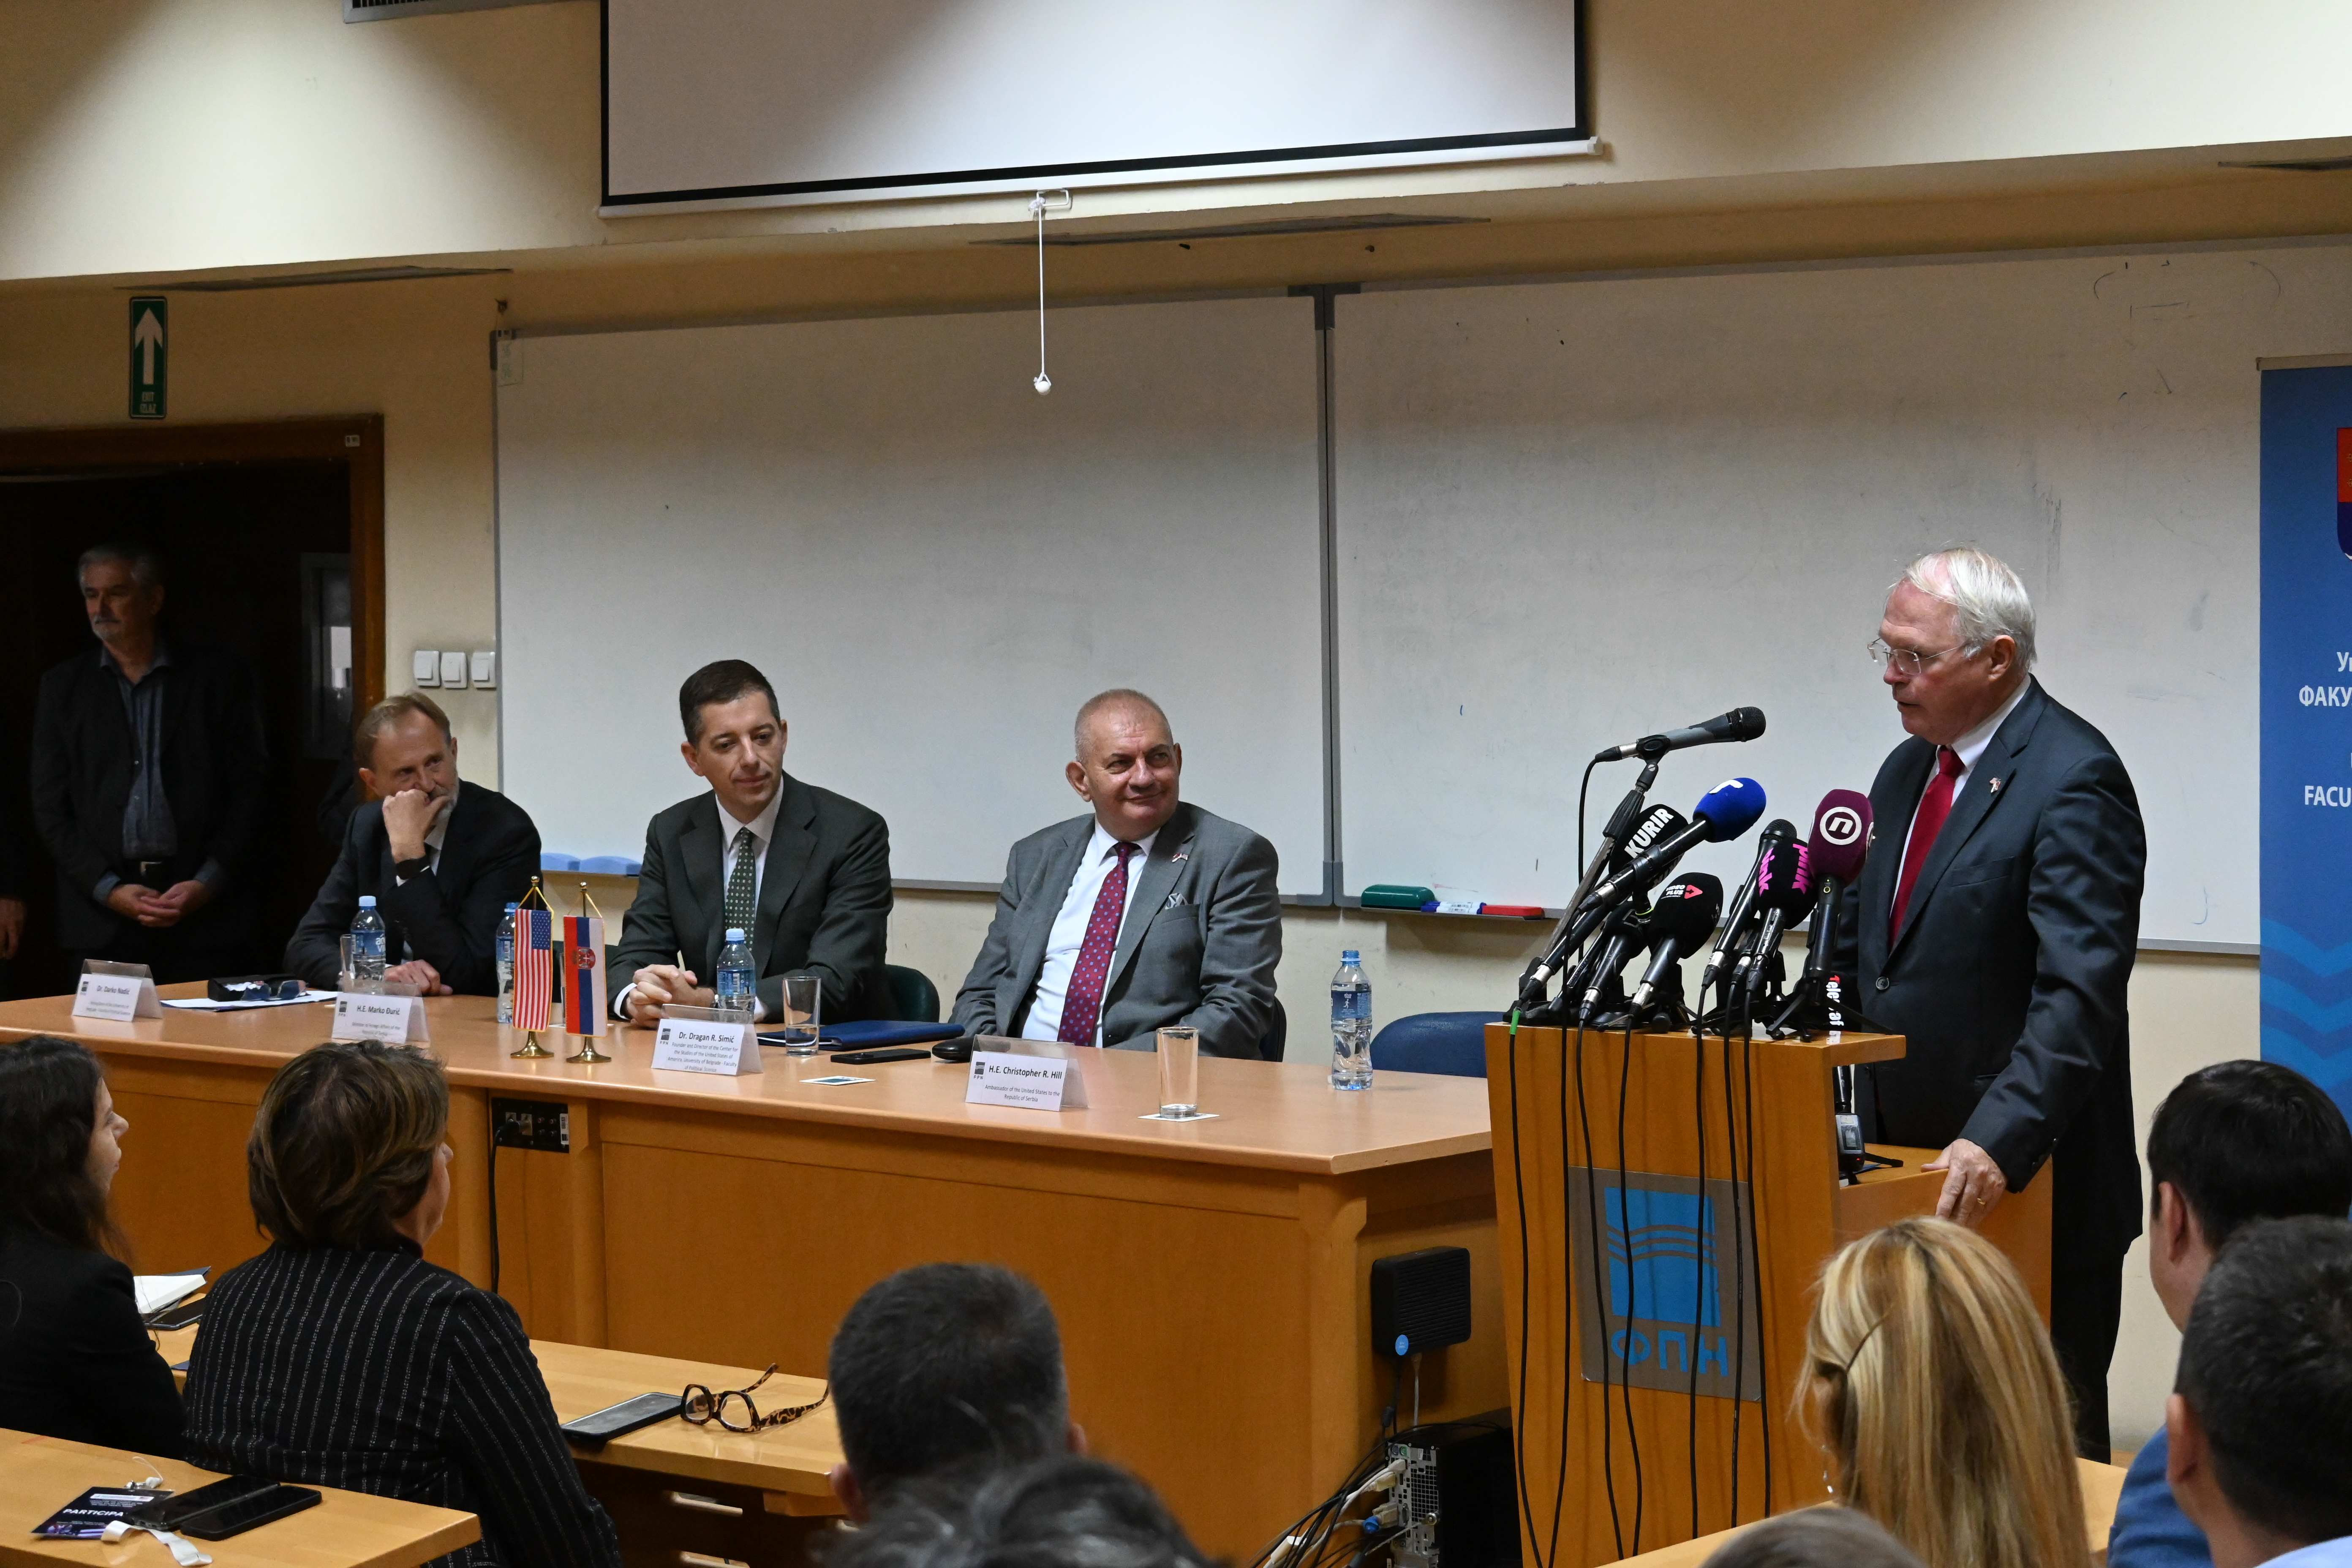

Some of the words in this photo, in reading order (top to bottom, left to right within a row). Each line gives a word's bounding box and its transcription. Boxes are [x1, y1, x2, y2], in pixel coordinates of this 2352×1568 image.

[2299, 686, 2352, 707] ФАКУ
[2305, 785, 2351, 807] FACU
[1624, 808, 1674, 858] KURIR
[1826, 975, 1844, 1026] Teleaf
[689, 1033, 709, 1042] Dragan
[718, 1035, 735, 1043] Simić
[989, 1065, 1001, 1073] H.E.
[1003, 1067, 1041, 1078] Christopher
[1051, 1071, 1062, 1079] Hill
[1611, 1326, 1728, 1376] ФПН
[63, 1508, 124, 1517] PARTICIPA
